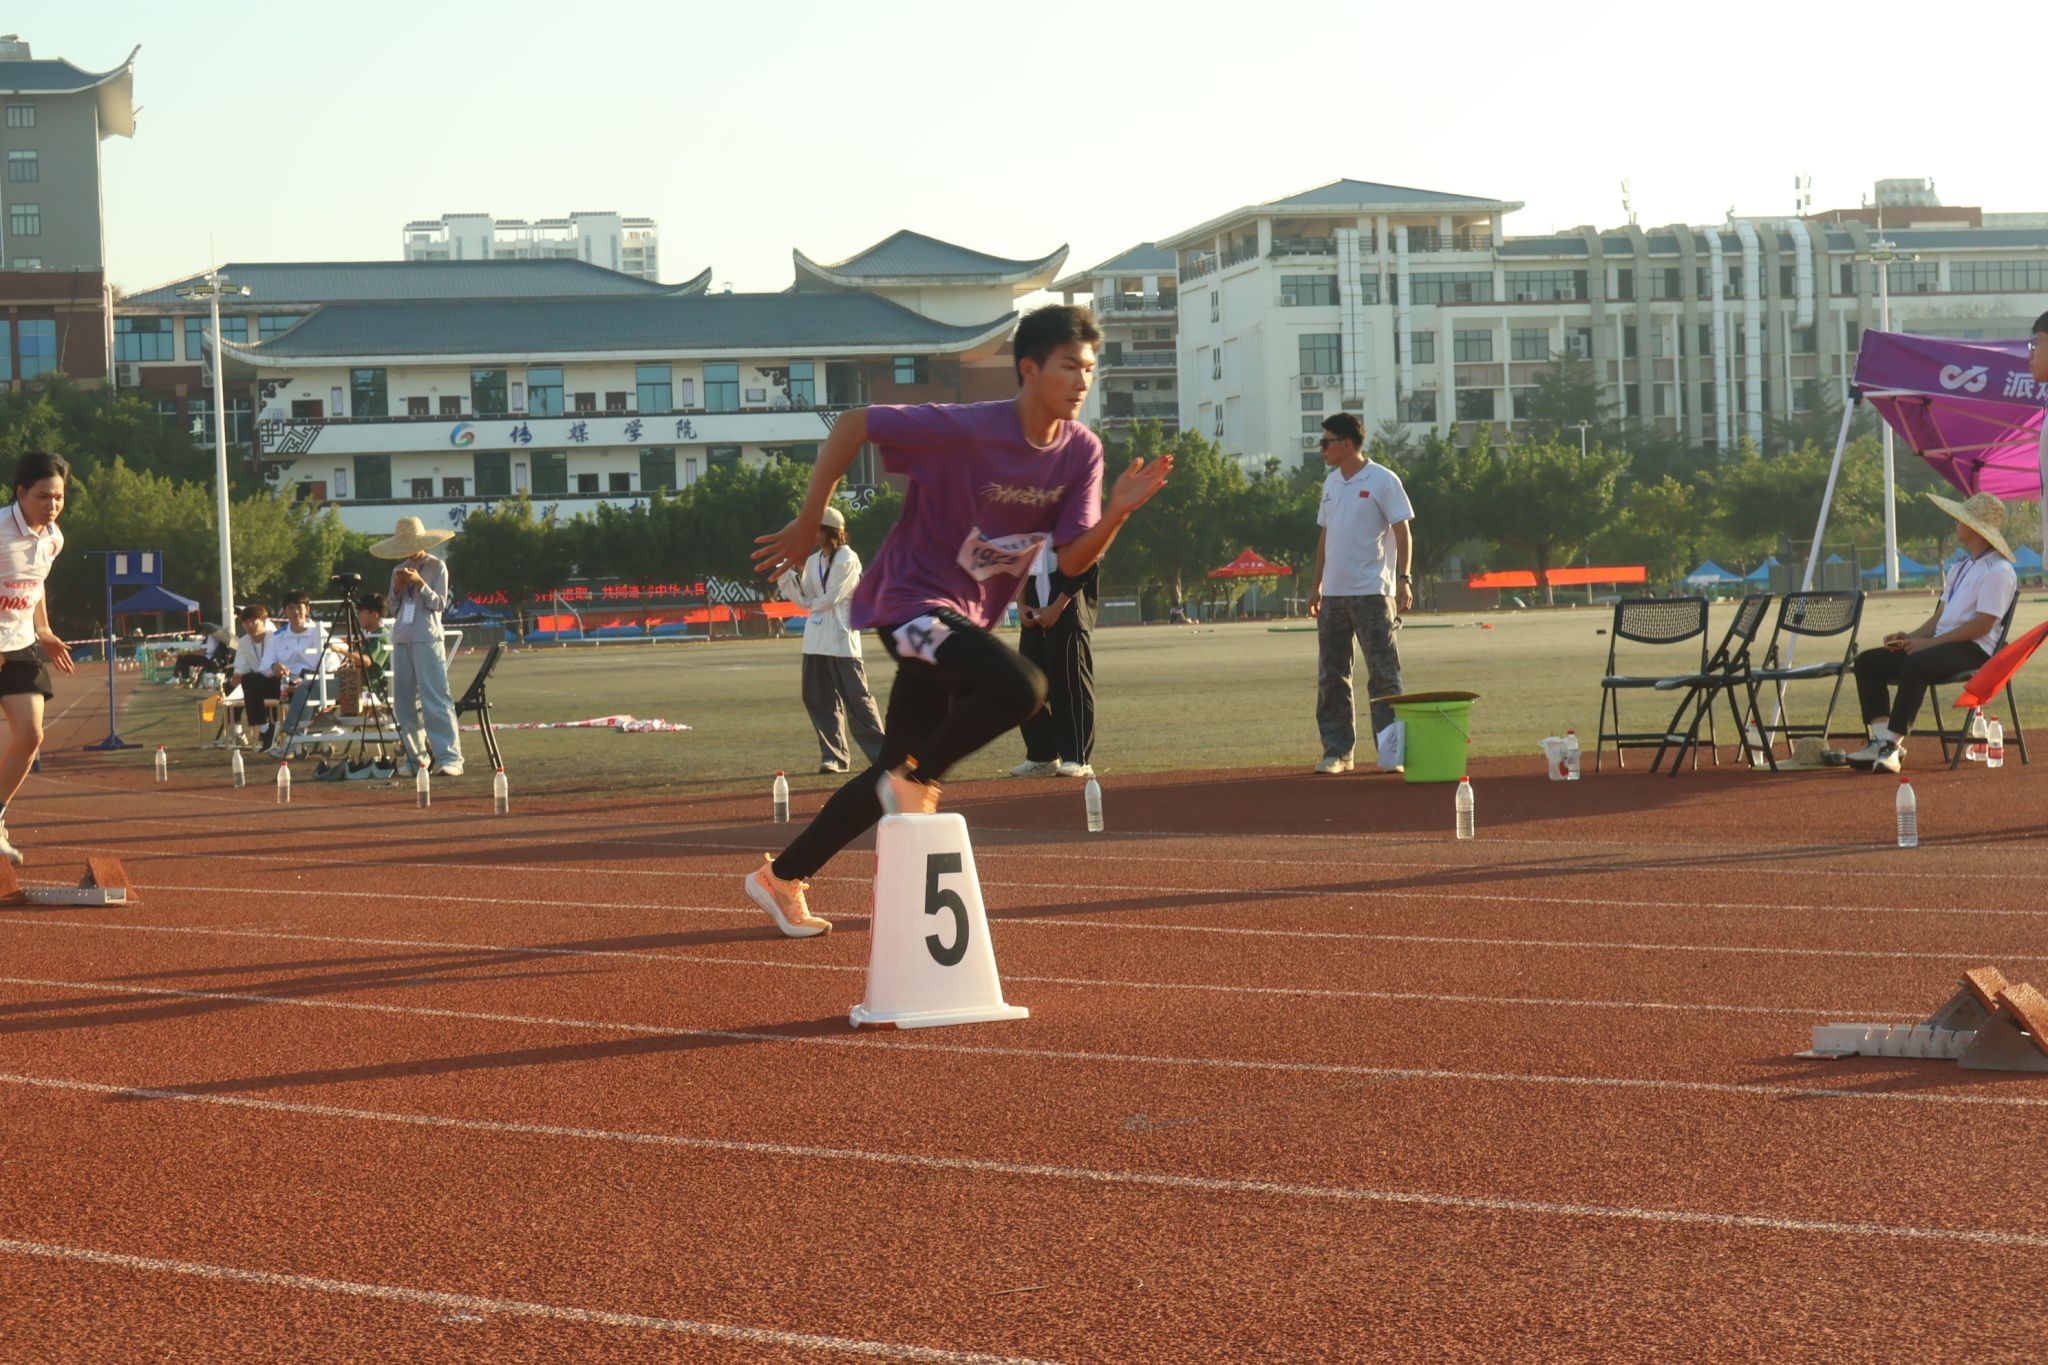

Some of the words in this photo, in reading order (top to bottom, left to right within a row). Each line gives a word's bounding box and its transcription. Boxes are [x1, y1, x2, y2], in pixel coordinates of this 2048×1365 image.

[509, 418, 698, 445] 传媒学院
[925, 852, 969, 966] 5
